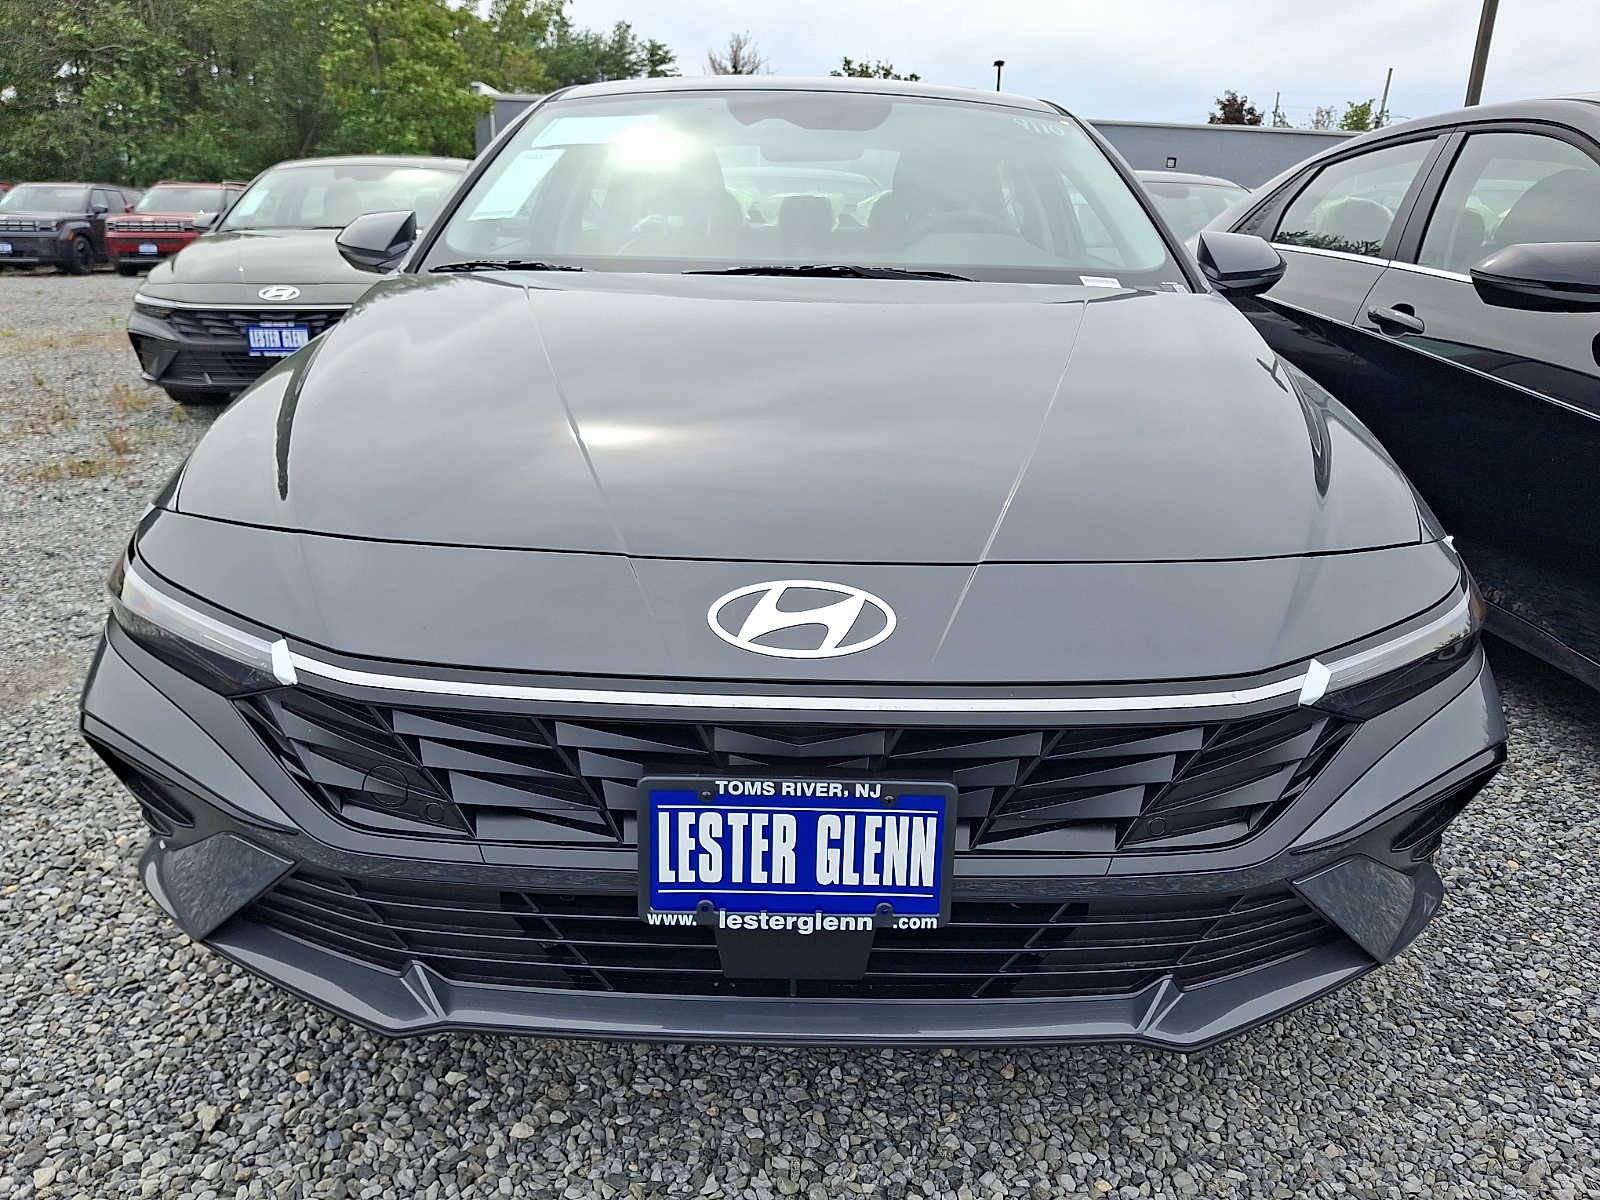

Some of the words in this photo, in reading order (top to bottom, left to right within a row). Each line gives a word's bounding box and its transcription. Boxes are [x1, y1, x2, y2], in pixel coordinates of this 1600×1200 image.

[715, 780, 775, 797] TOMS
[782, 781, 849, 798] RIVER,
[855, 783, 882, 798] NJ
[657, 811, 797, 884] LESTER
[816, 814, 938, 888] GLENN
[647, 912, 697, 926] www.
[719, 910, 873, 935] lesterglenn
[892, 916, 938, 929] .com
